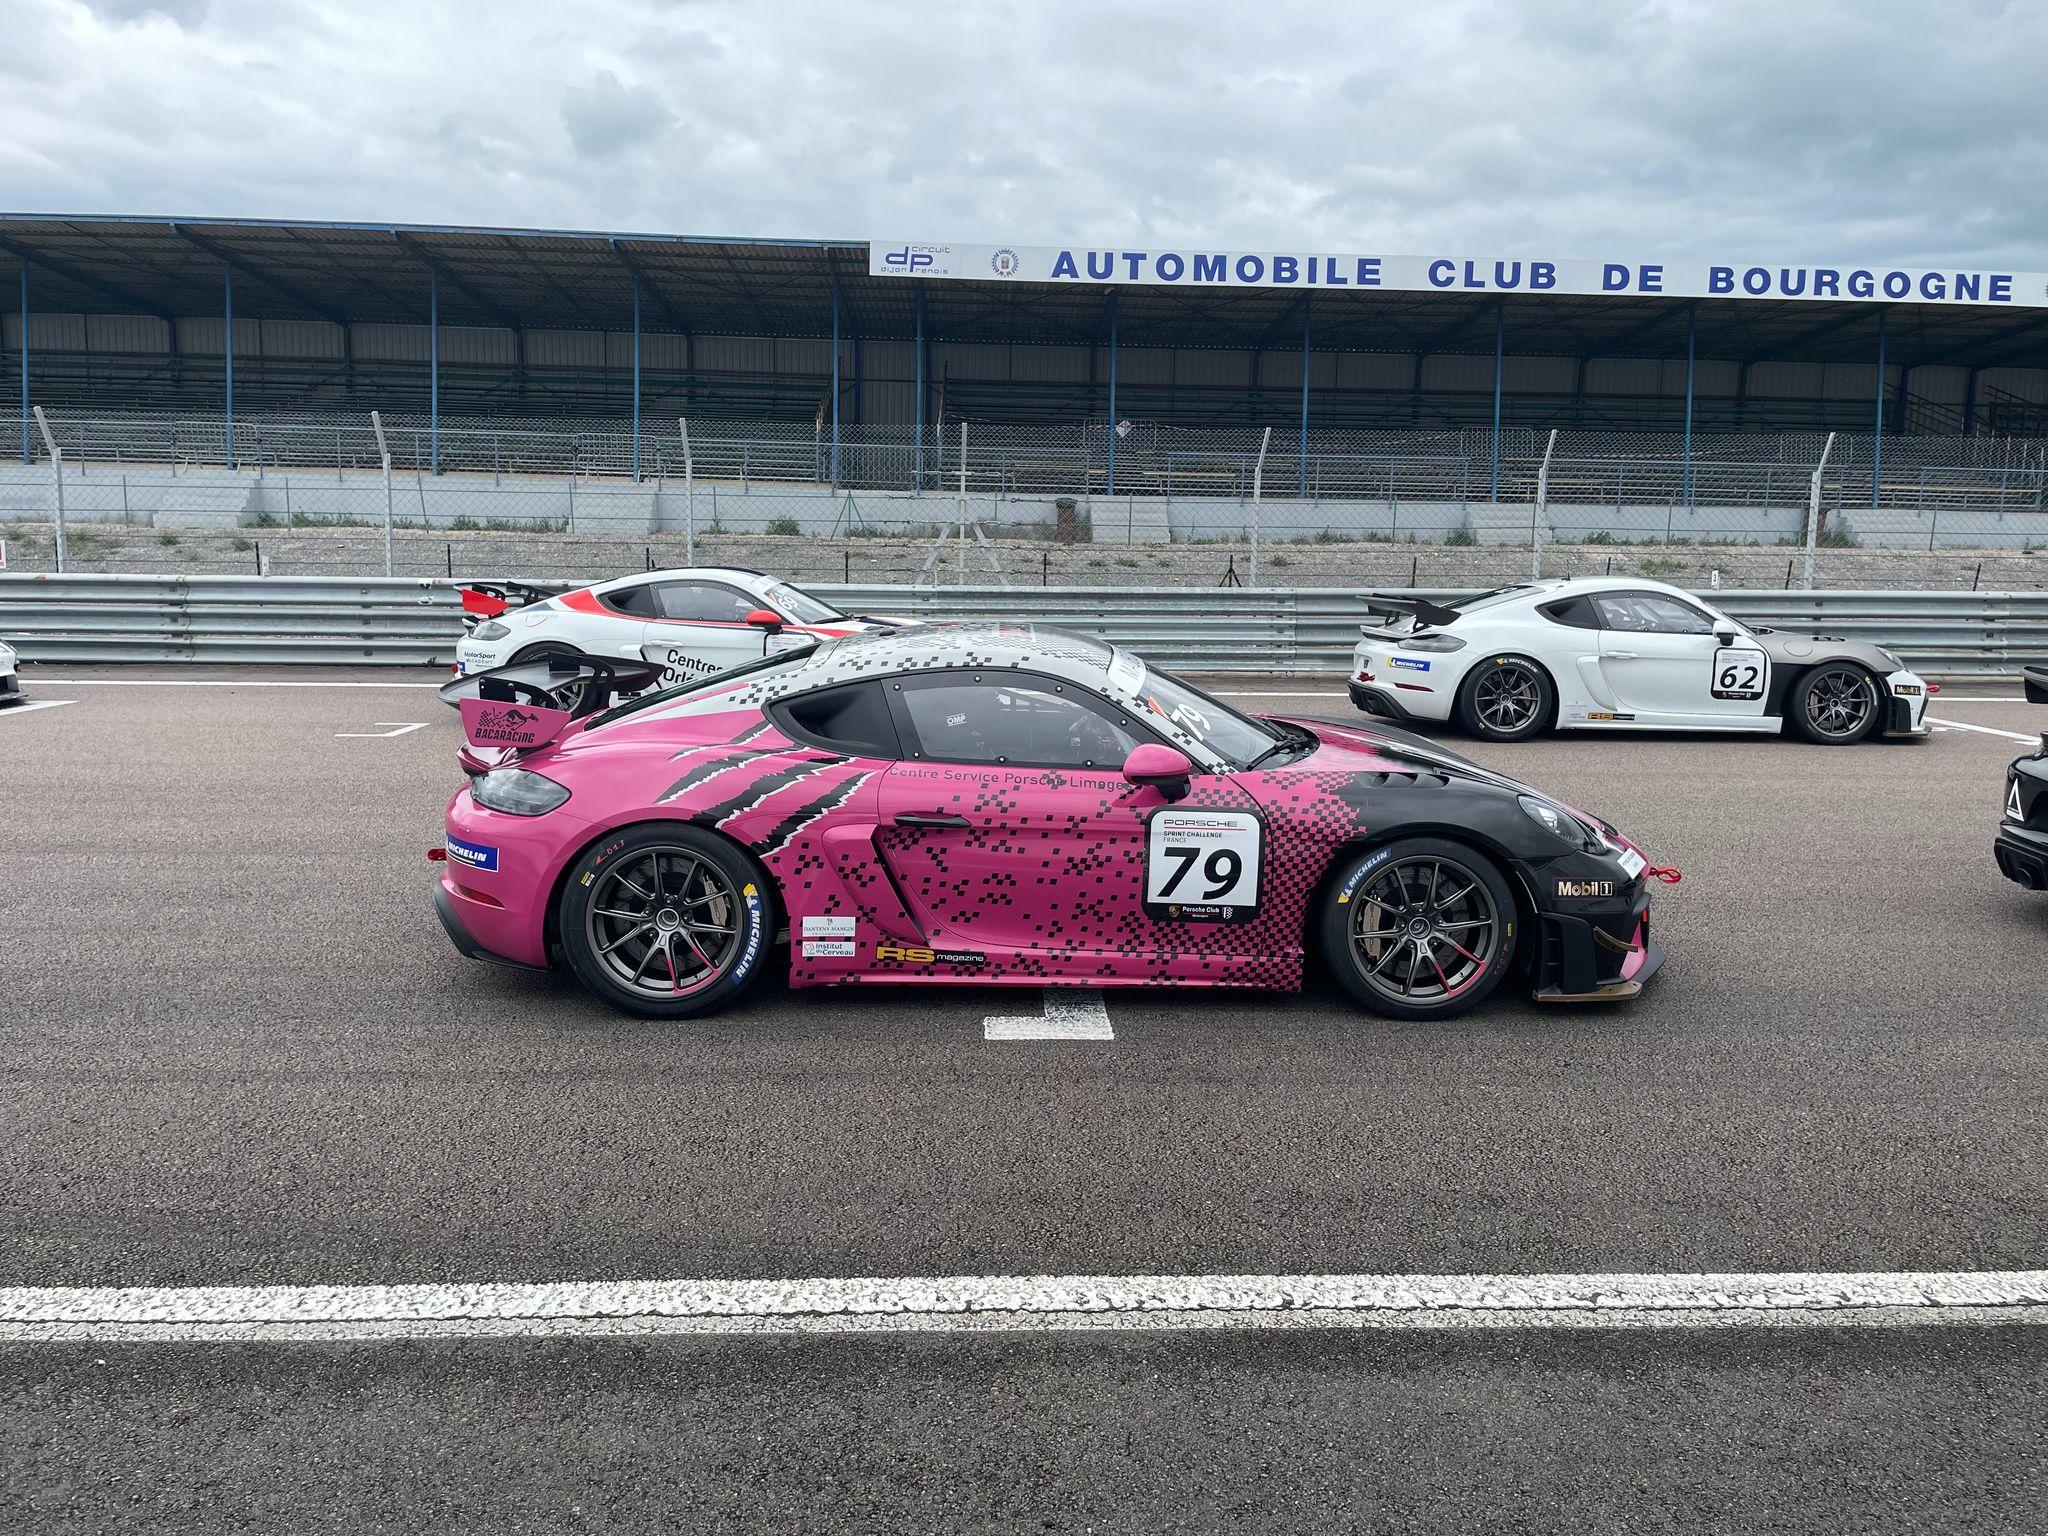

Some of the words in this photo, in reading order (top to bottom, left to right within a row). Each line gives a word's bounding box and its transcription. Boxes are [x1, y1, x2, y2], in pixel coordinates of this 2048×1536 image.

[911, 246, 951, 254] circuit
[880, 266, 907, 274] dijon
[1050, 250, 1382, 286] AUTOMOBILE
[1427, 259, 1557, 290] CLUB
[1601, 263, 1665, 293] DE
[1708, 266, 2014, 302] BOURGOGNE
[1396, 660, 1425, 668] MICHELIN
[1508, 658, 1538, 673] MICHELIN
[1720, 665, 1759, 690] 62
[946, 714, 966, 725] OMP
[1169, 703, 1211, 742] 79
[1588, 712, 1614, 720] RS
[889, 767, 939, 780] Centre
[944, 769, 999, 783] Service
[1163, 819, 1238, 828] PORSCHE
[1163, 836, 1187, 844] FRANCE
[1186, 831, 1223, 839] CHALLENGE
[448, 841, 488, 862] MICHELIN
[1156, 846, 1243, 901] 79
[1348, 850, 1388, 888] MICHELIN
[1558, 881, 1599, 897] Mobil
[1182, 905, 1205, 913] Porsche
[735, 909, 761, 978] MICHELIN
[876, 946, 935, 963] RS
[936, 953, 985, 963] magazine
